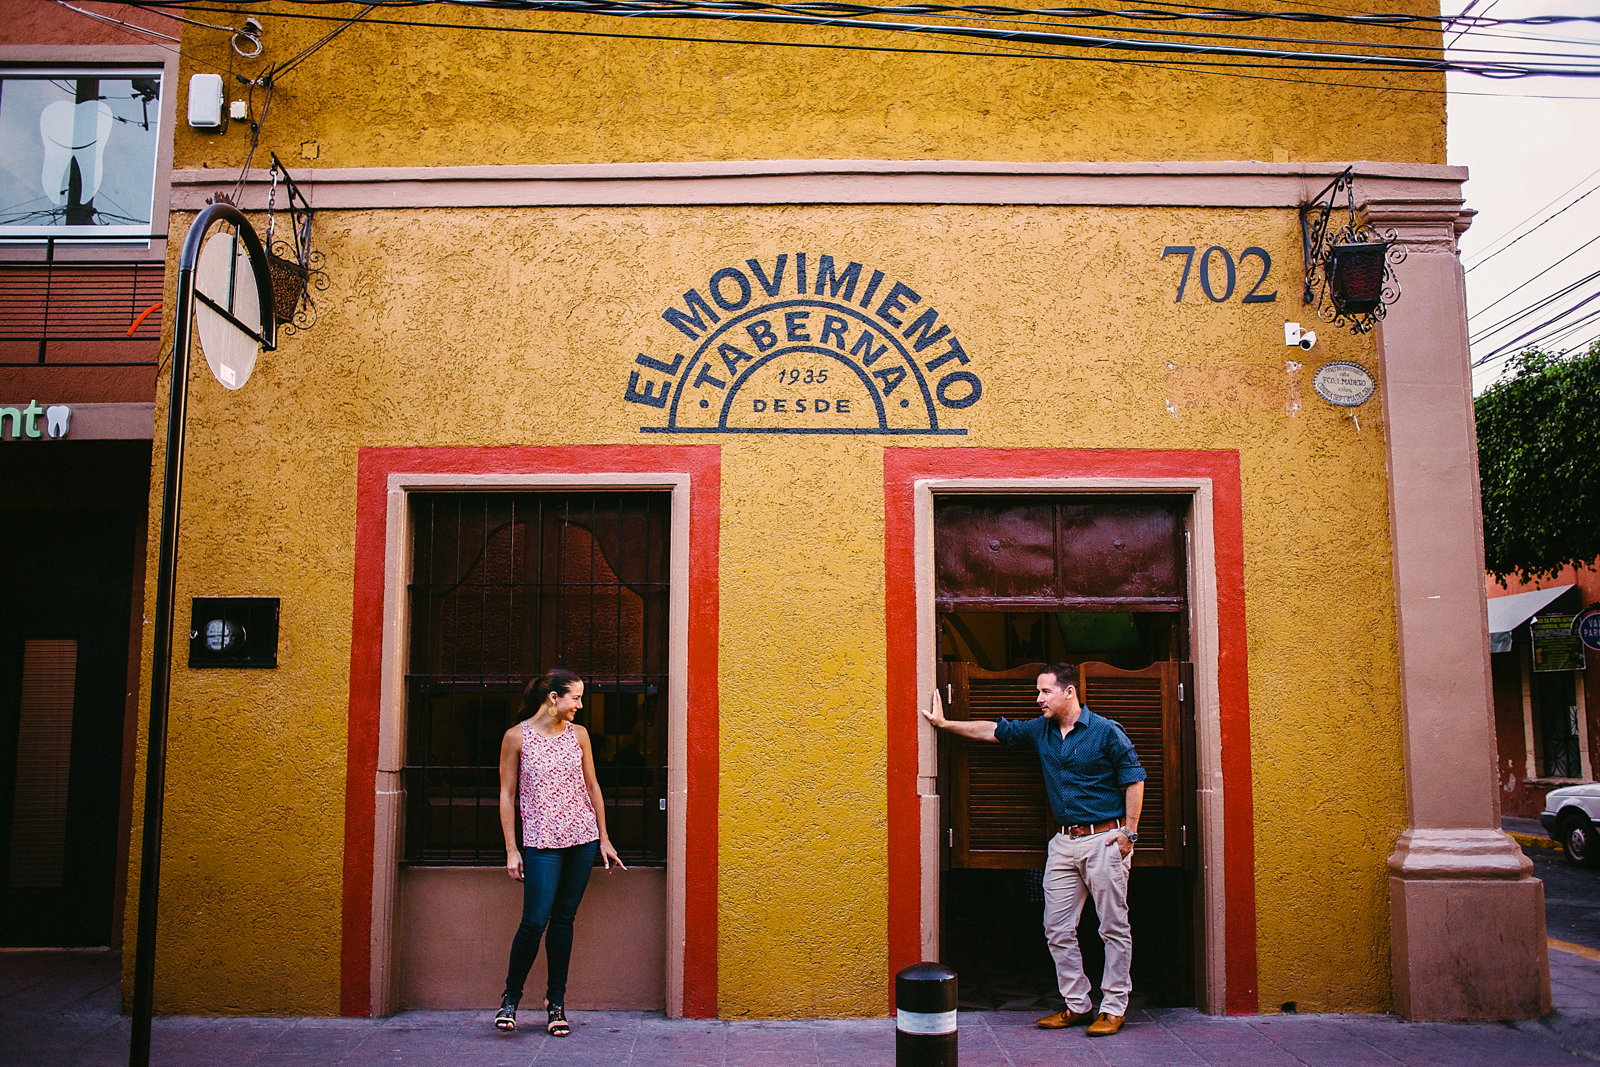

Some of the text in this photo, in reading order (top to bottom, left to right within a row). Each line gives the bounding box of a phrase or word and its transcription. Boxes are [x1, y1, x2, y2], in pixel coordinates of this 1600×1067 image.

[1160, 246, 1278, 303] 702
[624, 252, 982, 410] EL MOVIMIENTO
[693, 311, 907, 397] TABERNA
[779, 369, 828, 385] 1935
[753, 399, 850, 413] DESDE
